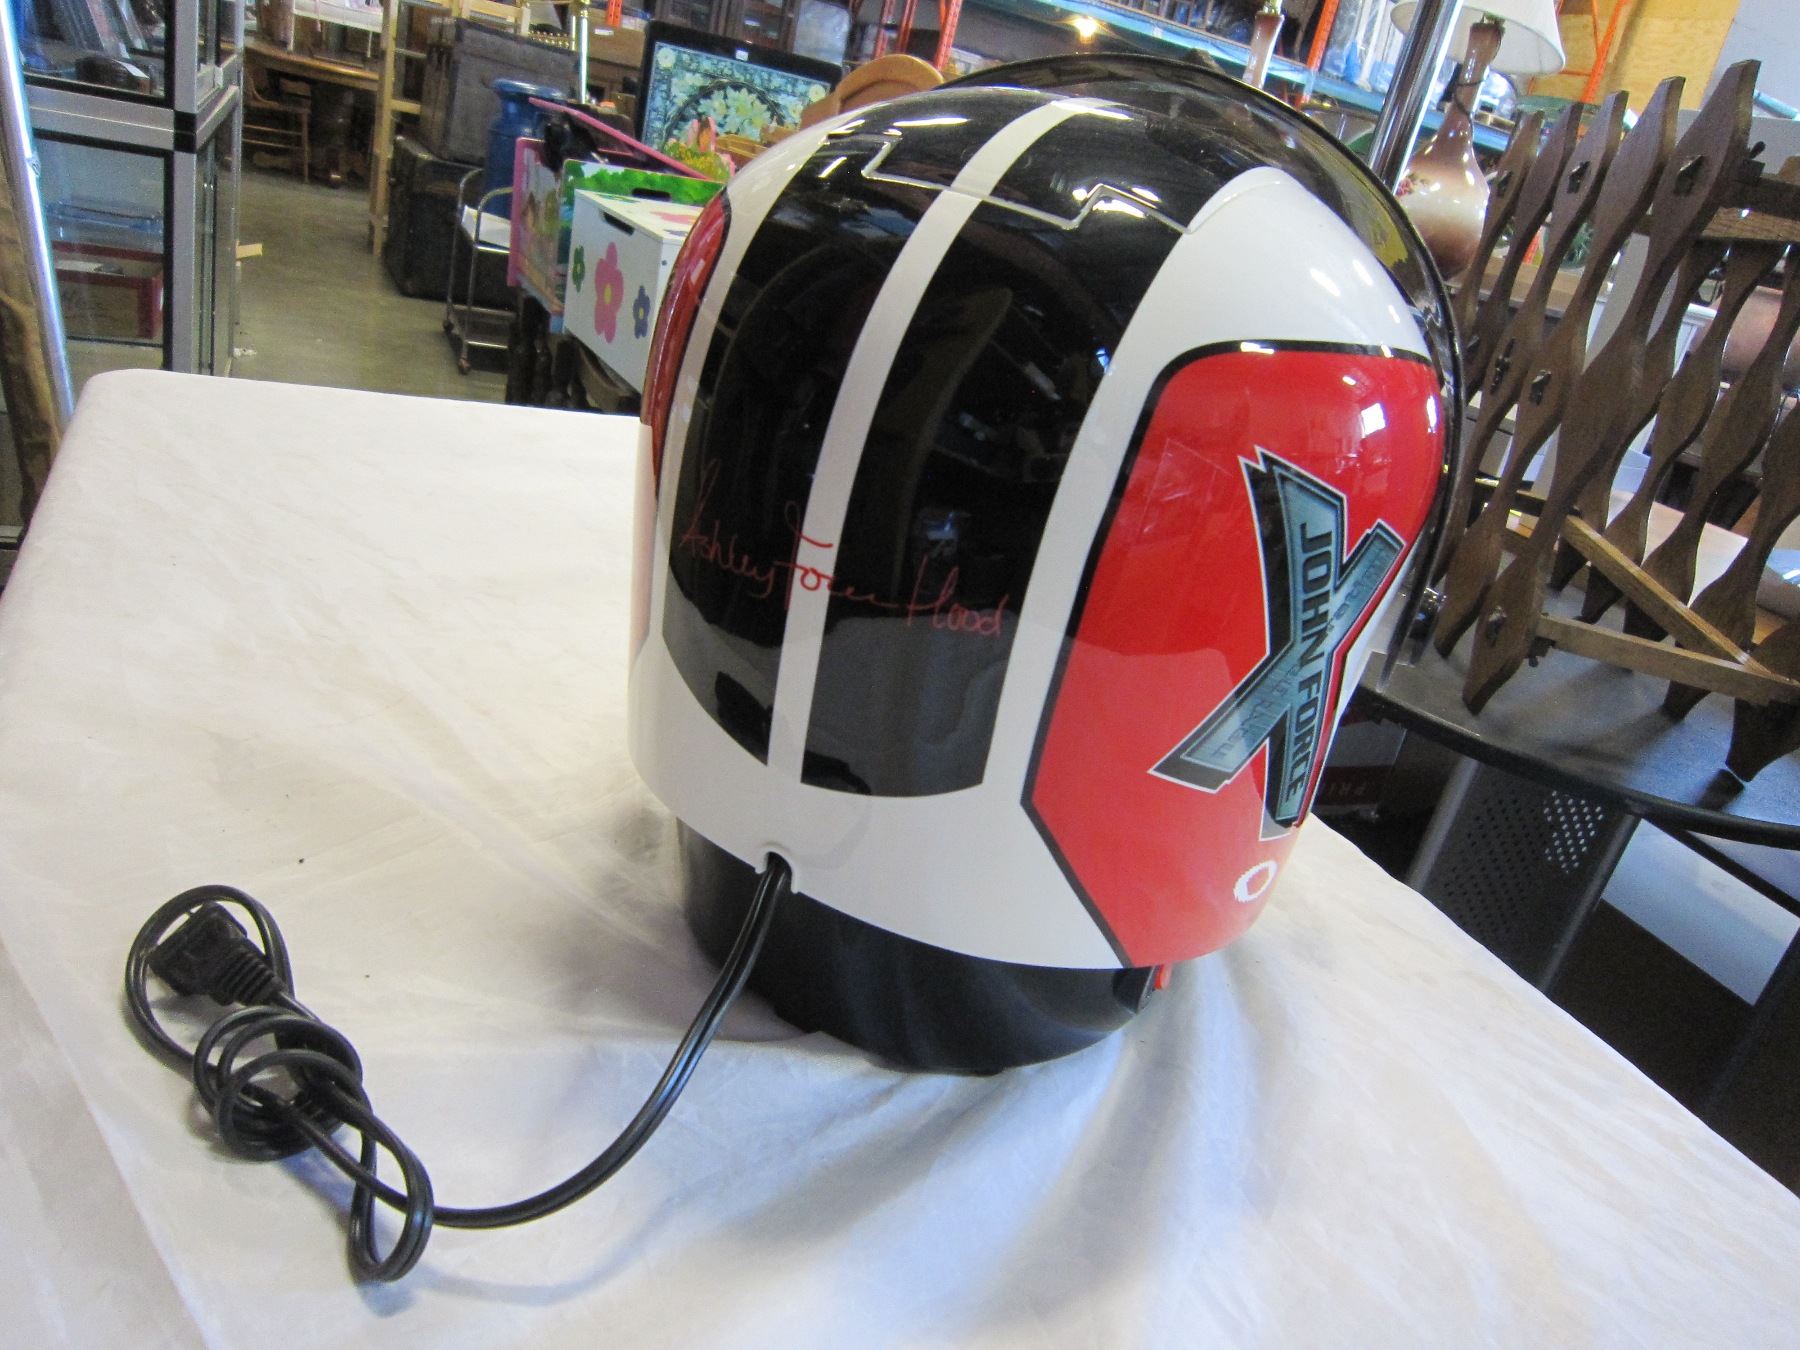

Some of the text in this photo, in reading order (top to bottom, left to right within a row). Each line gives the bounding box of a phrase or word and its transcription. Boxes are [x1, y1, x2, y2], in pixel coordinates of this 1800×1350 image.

[678, 457, 776, 598] Ashley
[1285, 521, 1334, 803] JOHN FORCE
